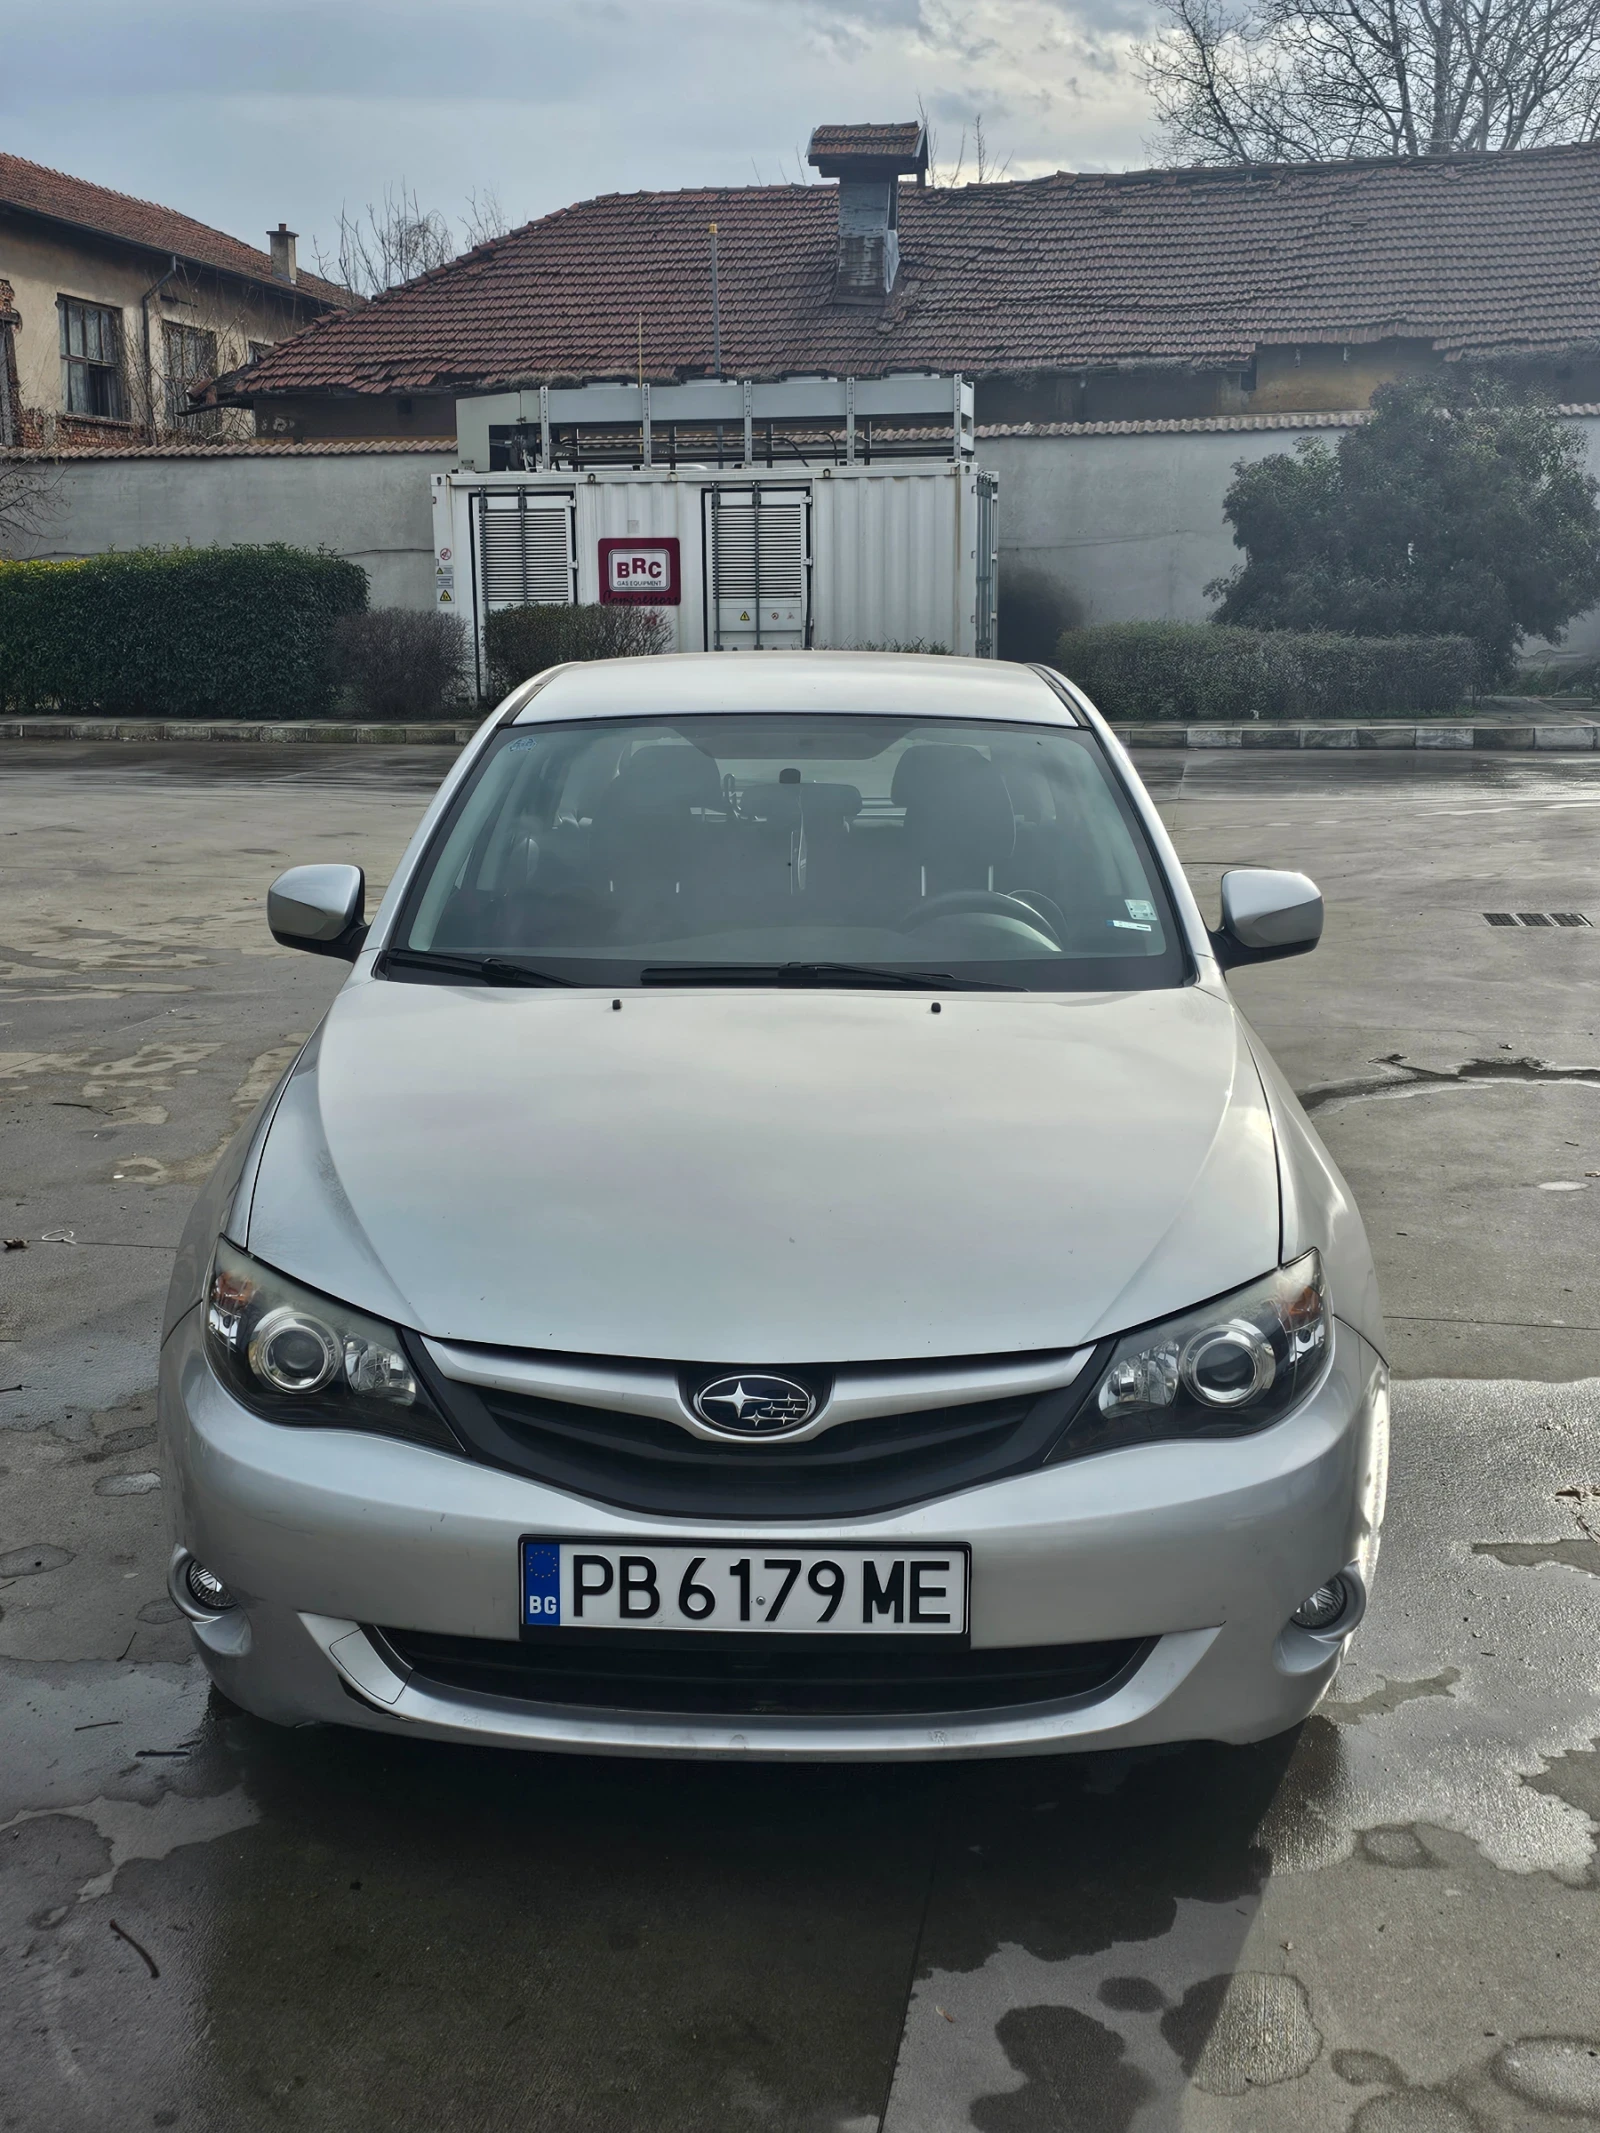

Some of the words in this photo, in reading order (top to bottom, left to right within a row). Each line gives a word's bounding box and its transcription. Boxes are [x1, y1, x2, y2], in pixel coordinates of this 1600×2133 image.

[616, 557, 662, 578] BRC
[573, 1554, 660, 1618] PB
[678, 1556, 845, 1623] 6179
[862, 1560, 951, 1624] ME
[529, 1595, 557, 1615] BG
